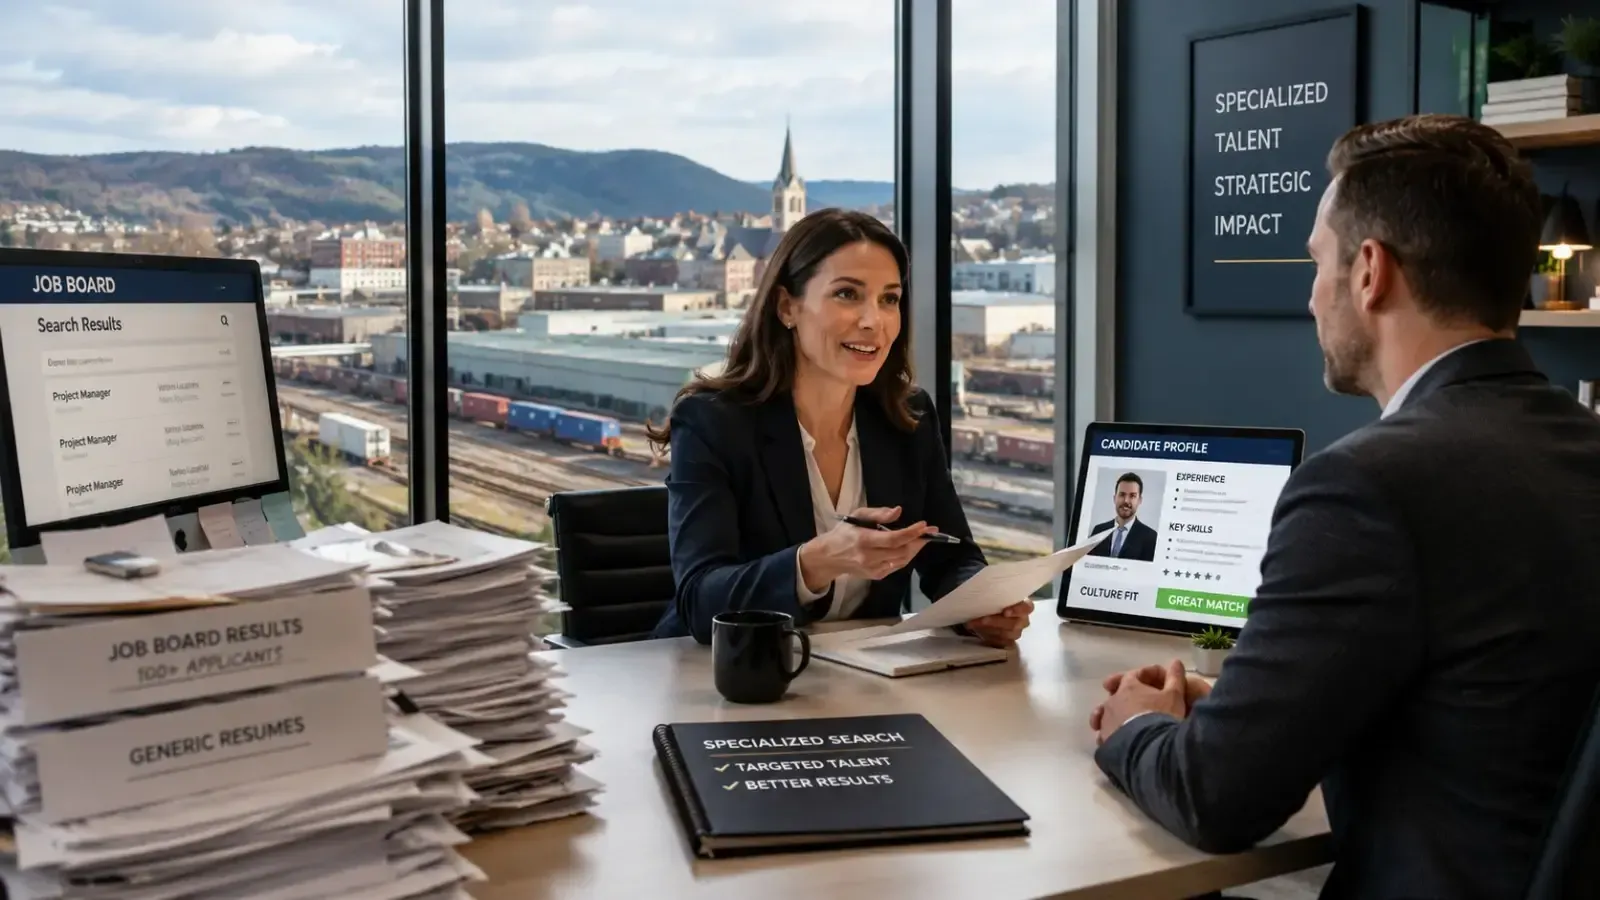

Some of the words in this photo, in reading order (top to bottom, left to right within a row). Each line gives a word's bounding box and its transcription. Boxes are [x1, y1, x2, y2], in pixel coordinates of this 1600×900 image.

[1214, 81, 1329, 114] SPECIALIZED
[1214, 127, 1283, 153] TALENT
[1214, 170, 1312, 197] STRATEGIC
[1214, 213, 1283, 236] IMPACT
[32, 274, 63, 294] JOB
[66, 276, 116, 294] BOARD
[37, 317, 79, 333] Search
[83, 316, 123, 332] Results
[52, 390, 79, 403] Project
[80, 388, 111, 401] Manager
[59, 436, 86, 451] Project
[87, 433, 118, 447] Manager
[1101, 438, 1161, 452] CANDIDATE
[1163, 442, 1209, 454] PROFILE
[66, 482, 93, 497] Project
[93, 477, 124, 492] Manager
[1176, 472, 1226, 484] EXPERIENCE
[1169, 523, 1185, 532] KEY
[1187, 524, 1213, 534] SKILLS
[1080, 586, 1123, 600] CULTURE
[1124, 590, 1139, 602] FIT
[1168, 594, 1204, 608] GREAT
[1206, 599, 1245, 613] MATCH
[109, 641, 148, 662] JOB
[154, 629, 221, 654] BOARD
[226, 618, 303, 643] RESULTS
[186, 646, 283, 674] APPLICANTS
[129, 733, 214, 766] GENERIC
[220, 717, 304, 747] RESUMES
[703, 736, 824, 750] SPECIALIZED
[829, 732, 905, 745] SEARCH
[735, 760, 824, 772] TARGETED
[826, 757, 891, 768] TALENT
[744, 779, 813, 790] BETTER
[816, 774, 894, 787] RESULTS
